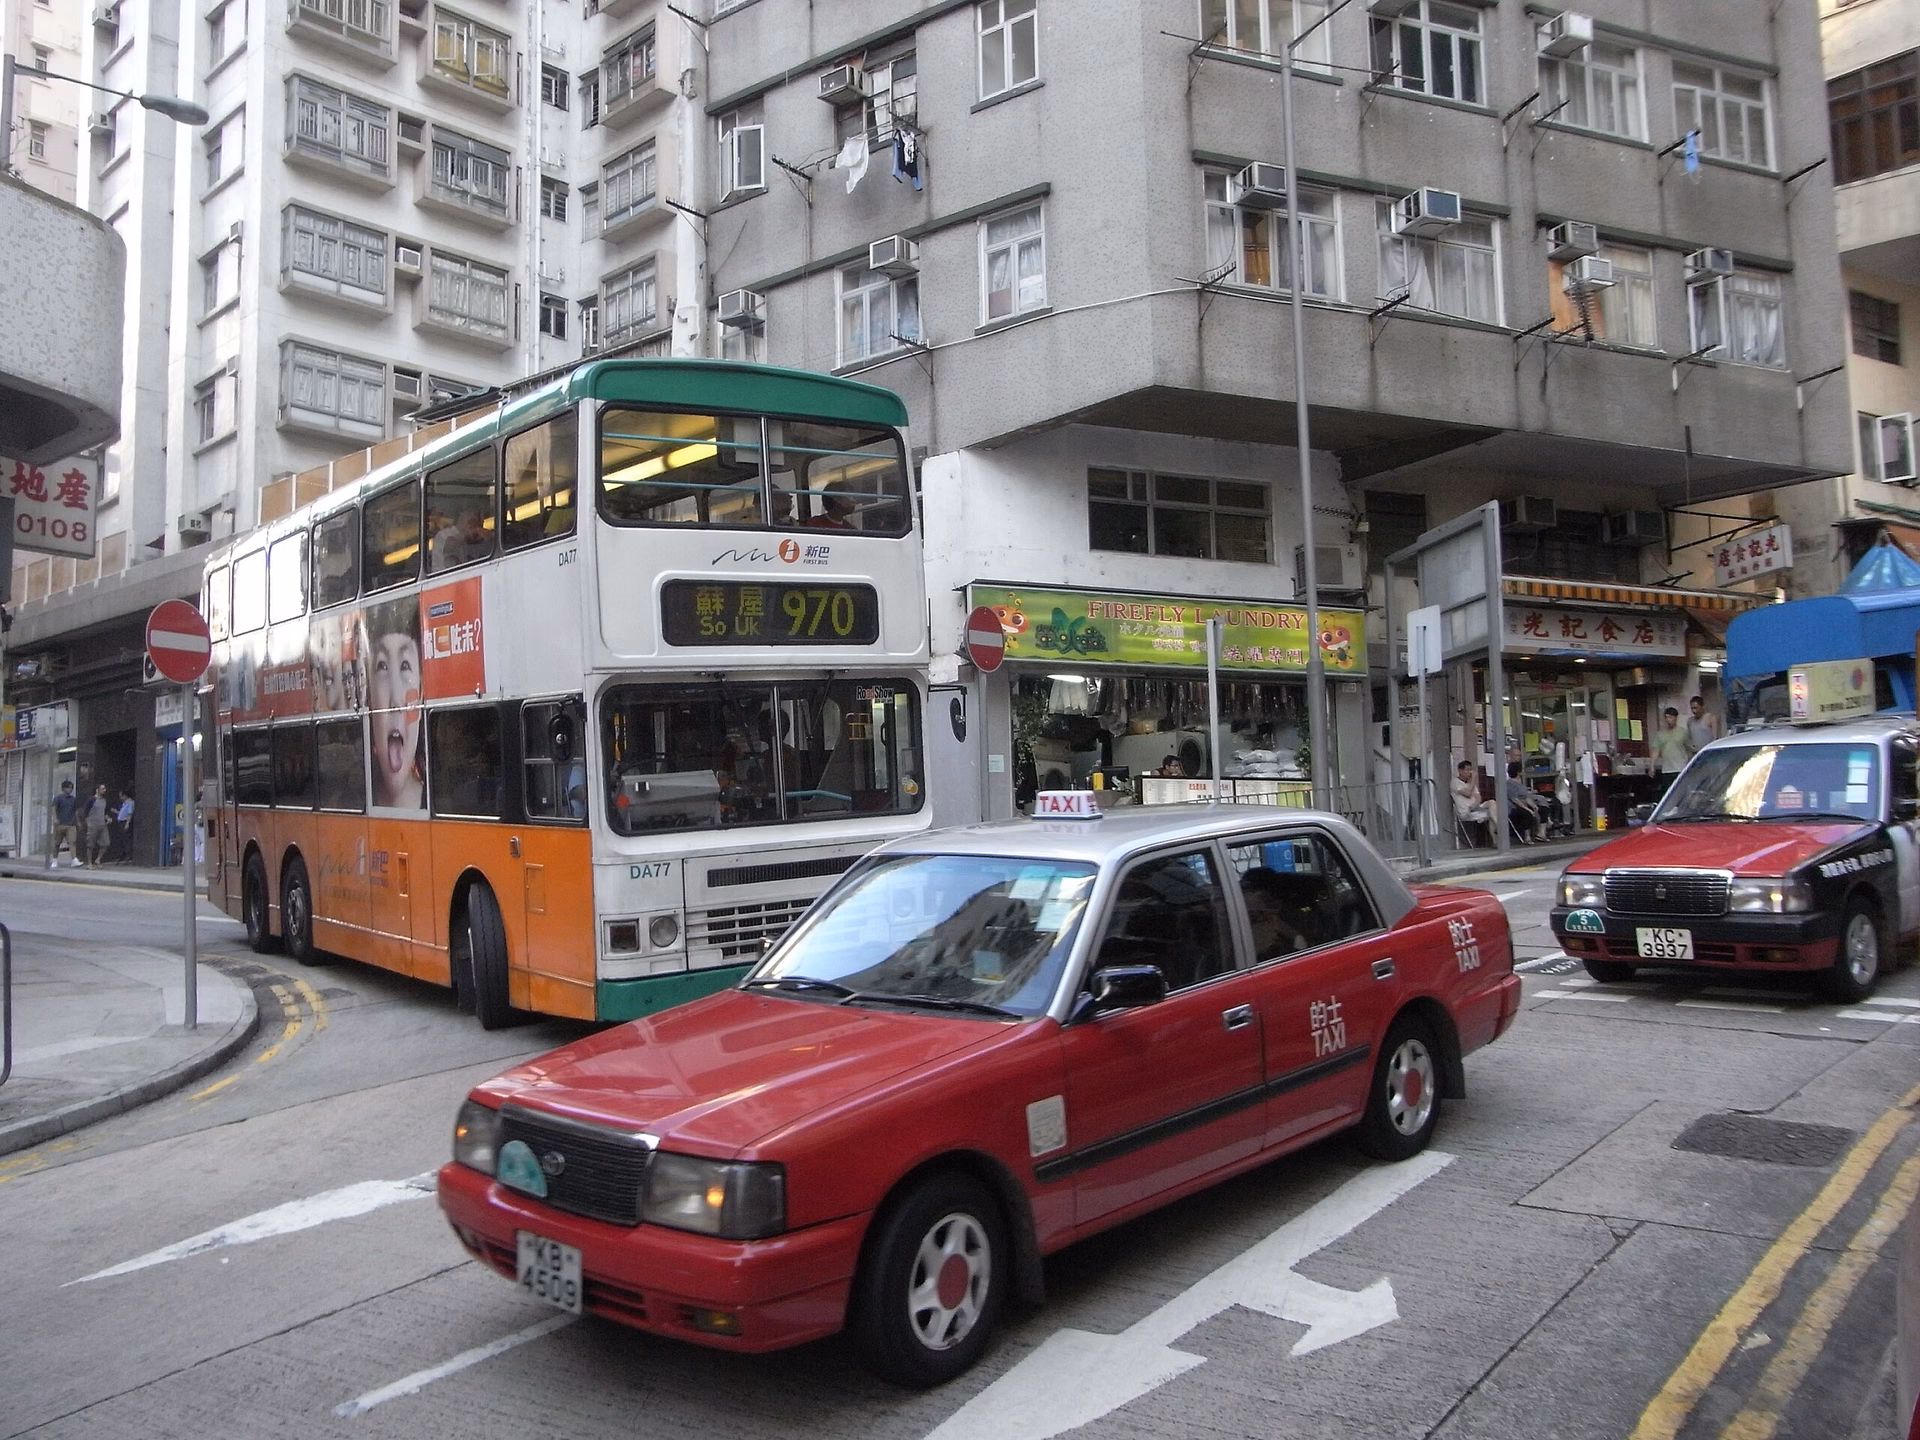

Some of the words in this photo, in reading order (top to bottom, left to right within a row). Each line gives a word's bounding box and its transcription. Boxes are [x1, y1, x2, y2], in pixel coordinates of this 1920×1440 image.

[16, 513, 87, 542] 0108
[558, 549, 577, 566] DA77
[804, 545, 830, 559] 新巴
[694, 586, 765, 616] 蘇屋
[782, 590, 854, 636] 970
[1087, 600, 1186, 624] FIREFLY
[700, 616, 726, 636] So
[734, 616, 759, 636] Uk
[1523, 611, 1655, 645] 光記食店
[1040, 795, 1080, 812] TAXI
[629, 862, 671, 880] DA77
[1448, 916, 1476, 948] 的士
[1580, 915, 1588, 925] 5
[1652, 929, 1675, 943] KC
[1456, 945, 1480, 972] TAXI
[1643, 942, 1688, 958] 3937
[1310, 995, 1343, 1029] 的士
[1311, 1022, 1346, 1057] TAXI
